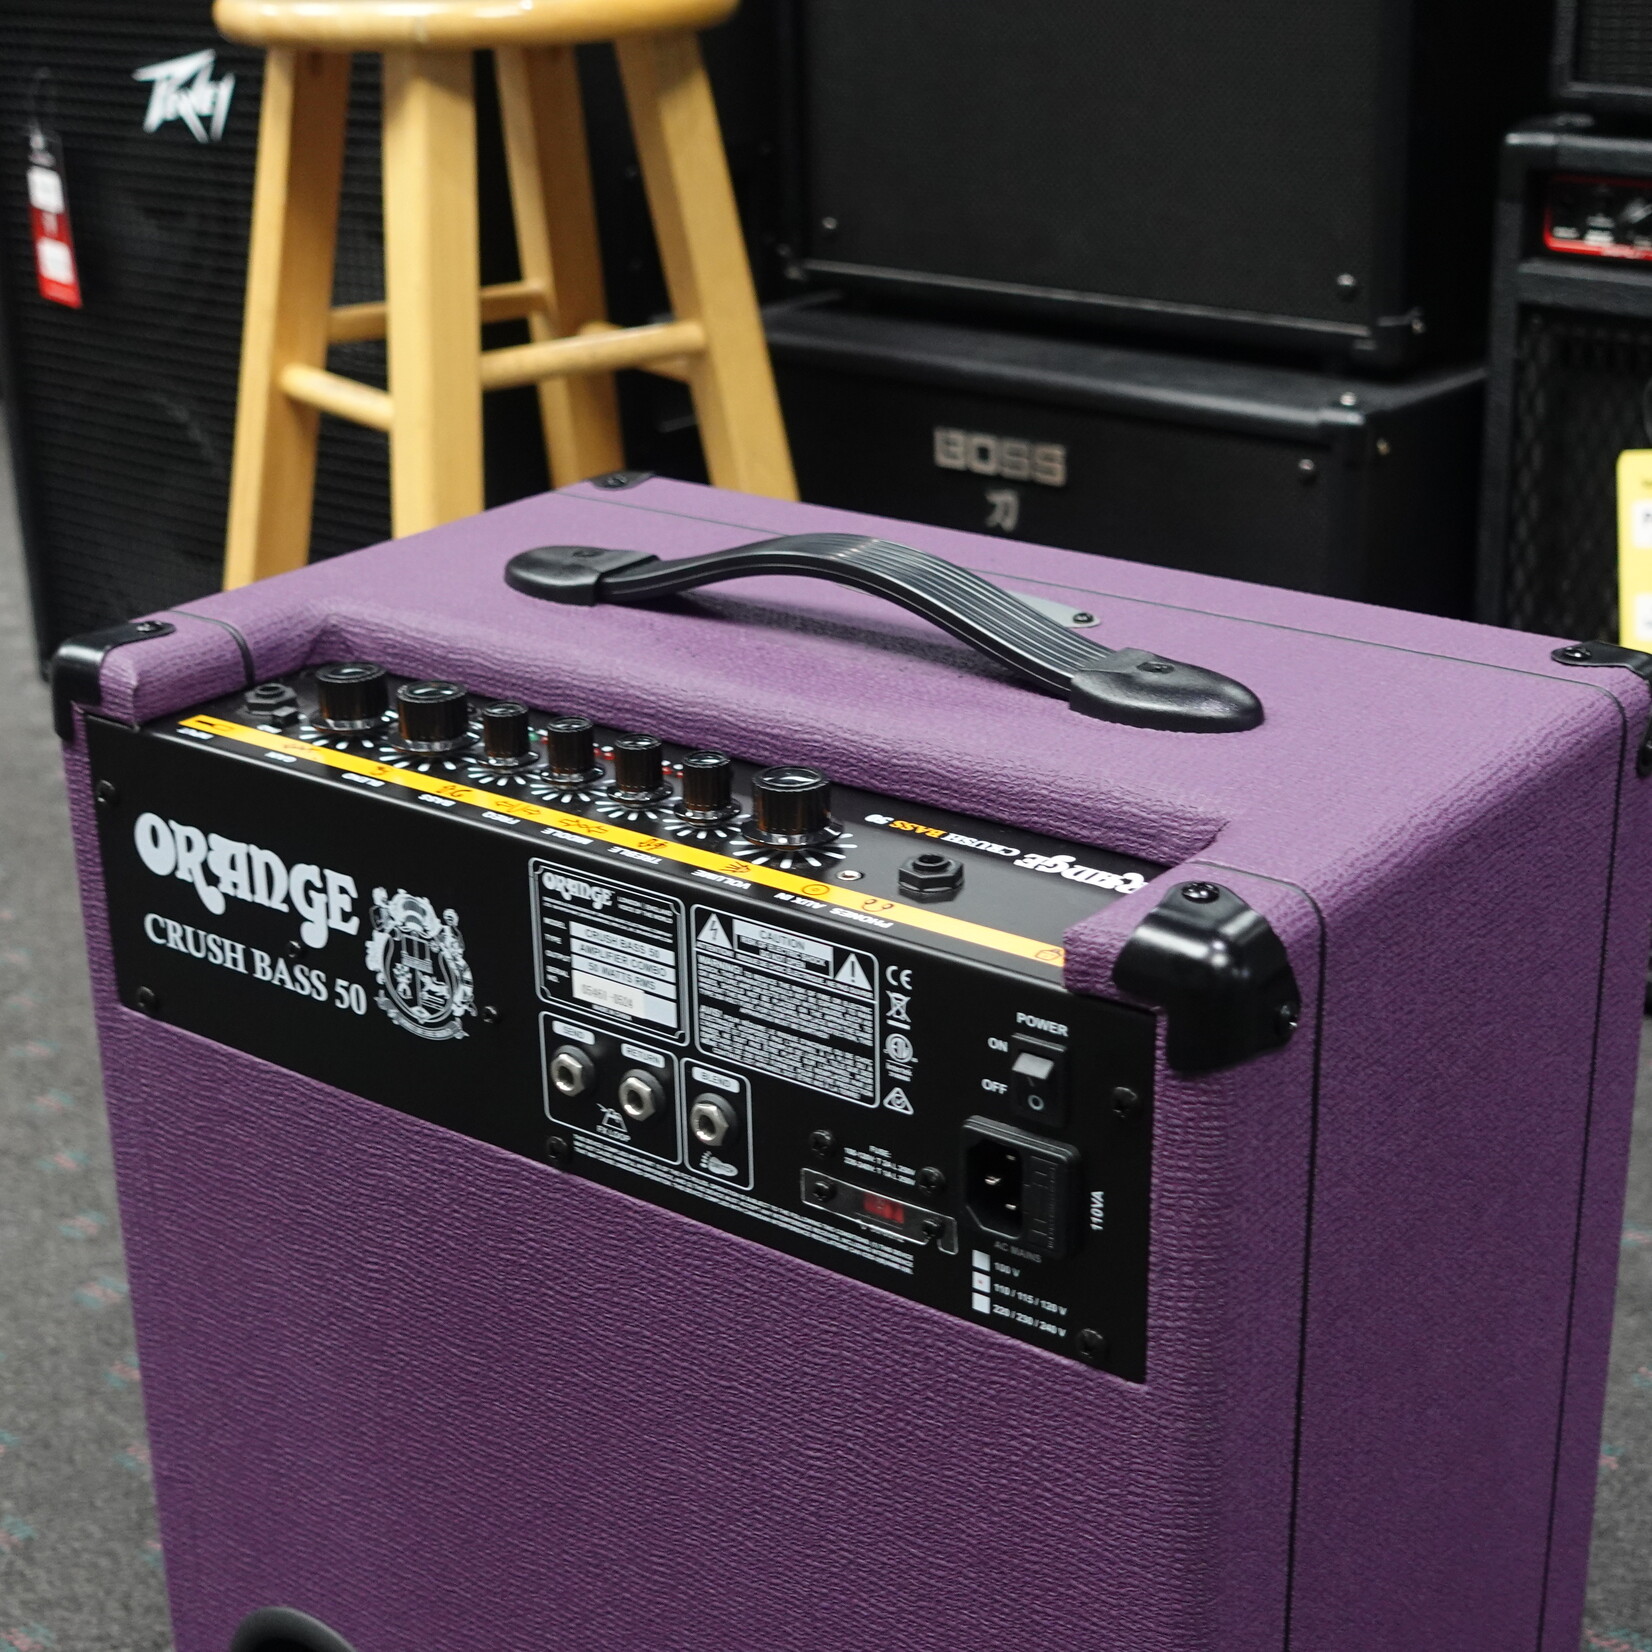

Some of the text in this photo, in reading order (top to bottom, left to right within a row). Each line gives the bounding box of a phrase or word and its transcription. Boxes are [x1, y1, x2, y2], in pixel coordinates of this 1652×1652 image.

[933, 426, 1067, 487] BOSS
[418, 793, 457, 807] BASS
[481, 811, 521, 825] FREQ
[540, 827, 594, 845] MIDDLE
[607, 845, 663, 865] TREBLE
[864, 813, 1149, 894] RANGE CRUSH BASS 50
[134, 811, 360, 949] ORANGE
[691, 869, 752, 890] VOLUME
[789, 894, 827, 910] AUX
[829, 907, 894, 928] PHONES
[585, 928, 618, 947] CRUSH
[620, 936, 647, 955] BASS
[649, 946, 661, 959] 50
[759, 930, 806, 950] CAUTION
[144, 913, 367, 1015] CRUSH BASS 50
[580, 944, 667, 978] AMPLIFIER COMBO
[588, 958, 657, 990] 50 WATTS RMS
[885, 965, 913, 990] CE
[1016, 1011, 1069, 1037] POWER
[987, 1037, 1009, 1052] ON
[701, 1071, 732, 1088] BLEND
[981, 1078, 1008, 1095] OFF
[1090, 1190, 1104, 1231] 110VA
